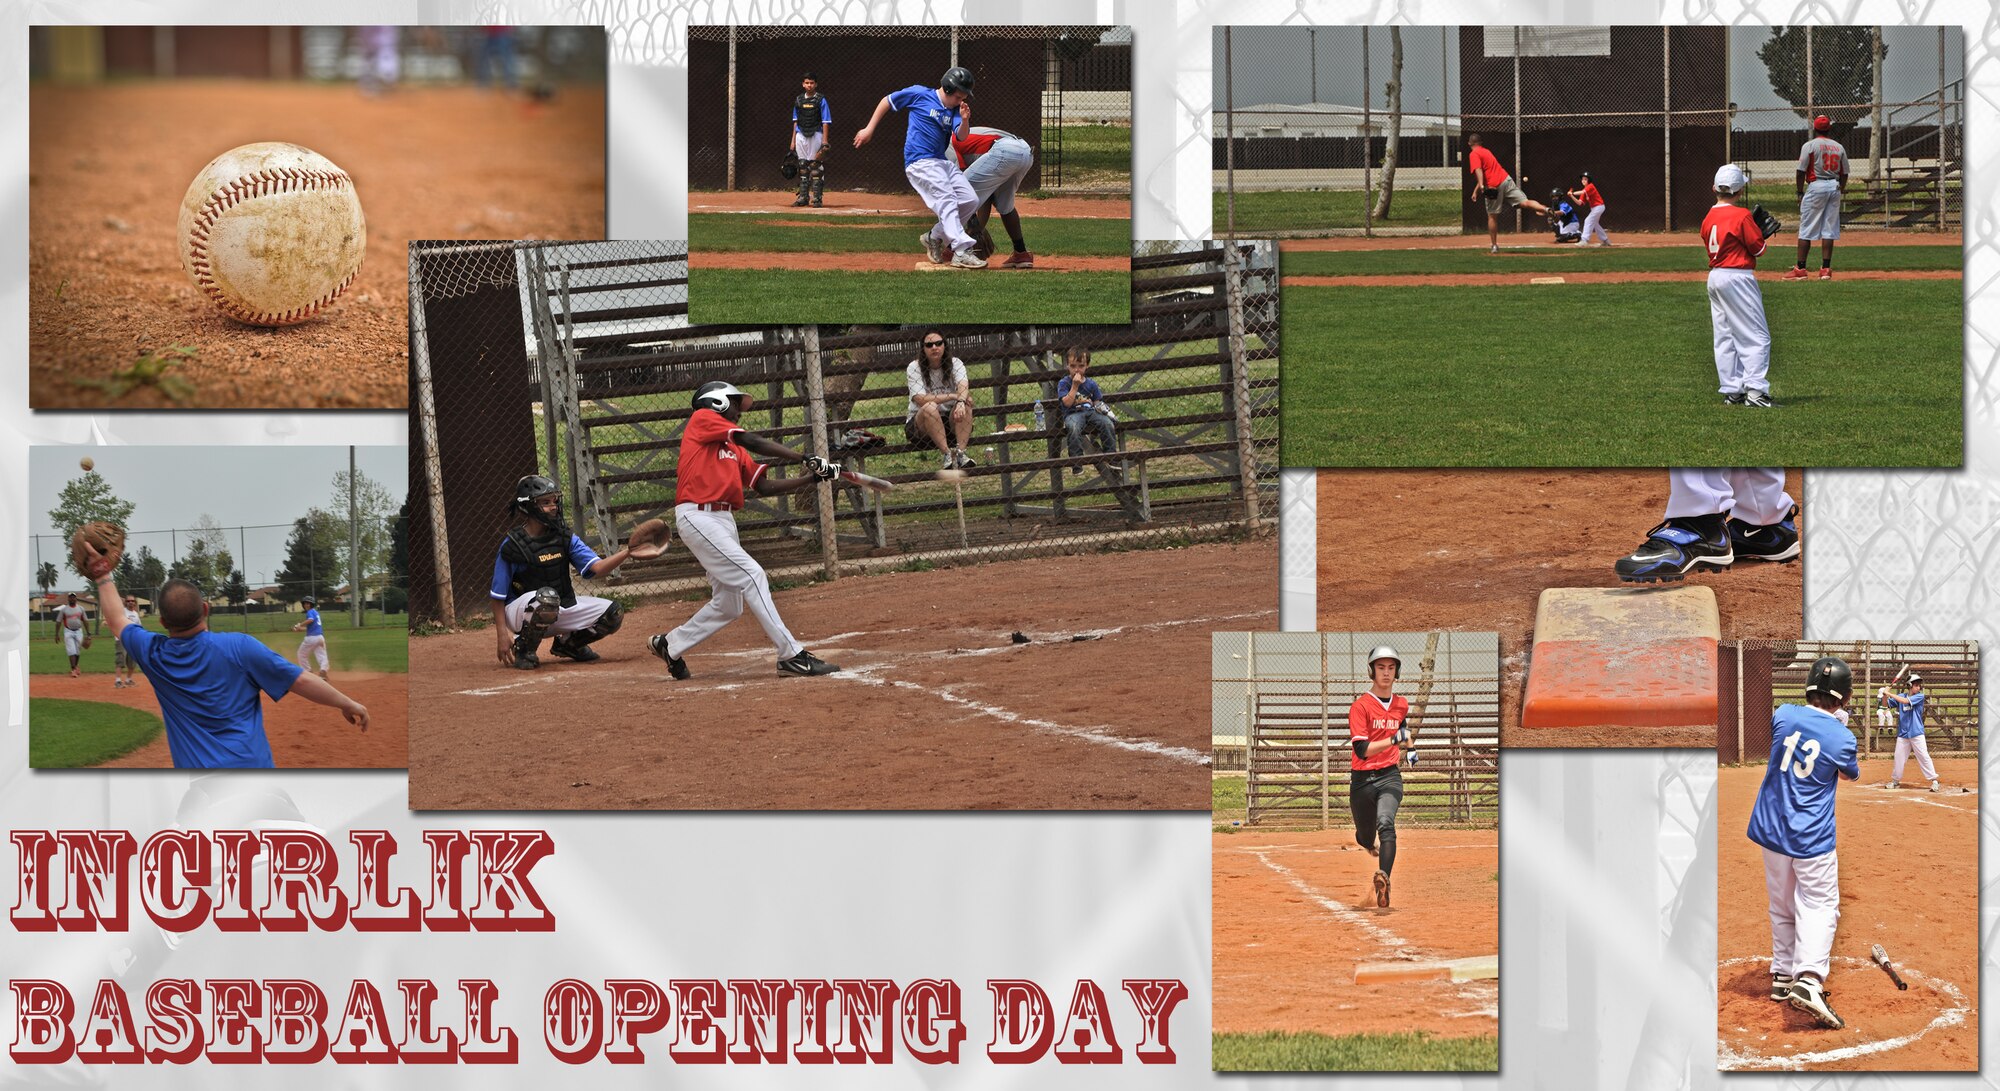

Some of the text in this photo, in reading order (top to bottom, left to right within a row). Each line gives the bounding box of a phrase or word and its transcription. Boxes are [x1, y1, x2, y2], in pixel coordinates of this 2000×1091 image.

[1708, 224, 1720, 254] 4
[1660, 529, 1681, 537] NIKE
[538, 553, 562, 562] Wilson
[1779, 730, 1821, 779] 13
